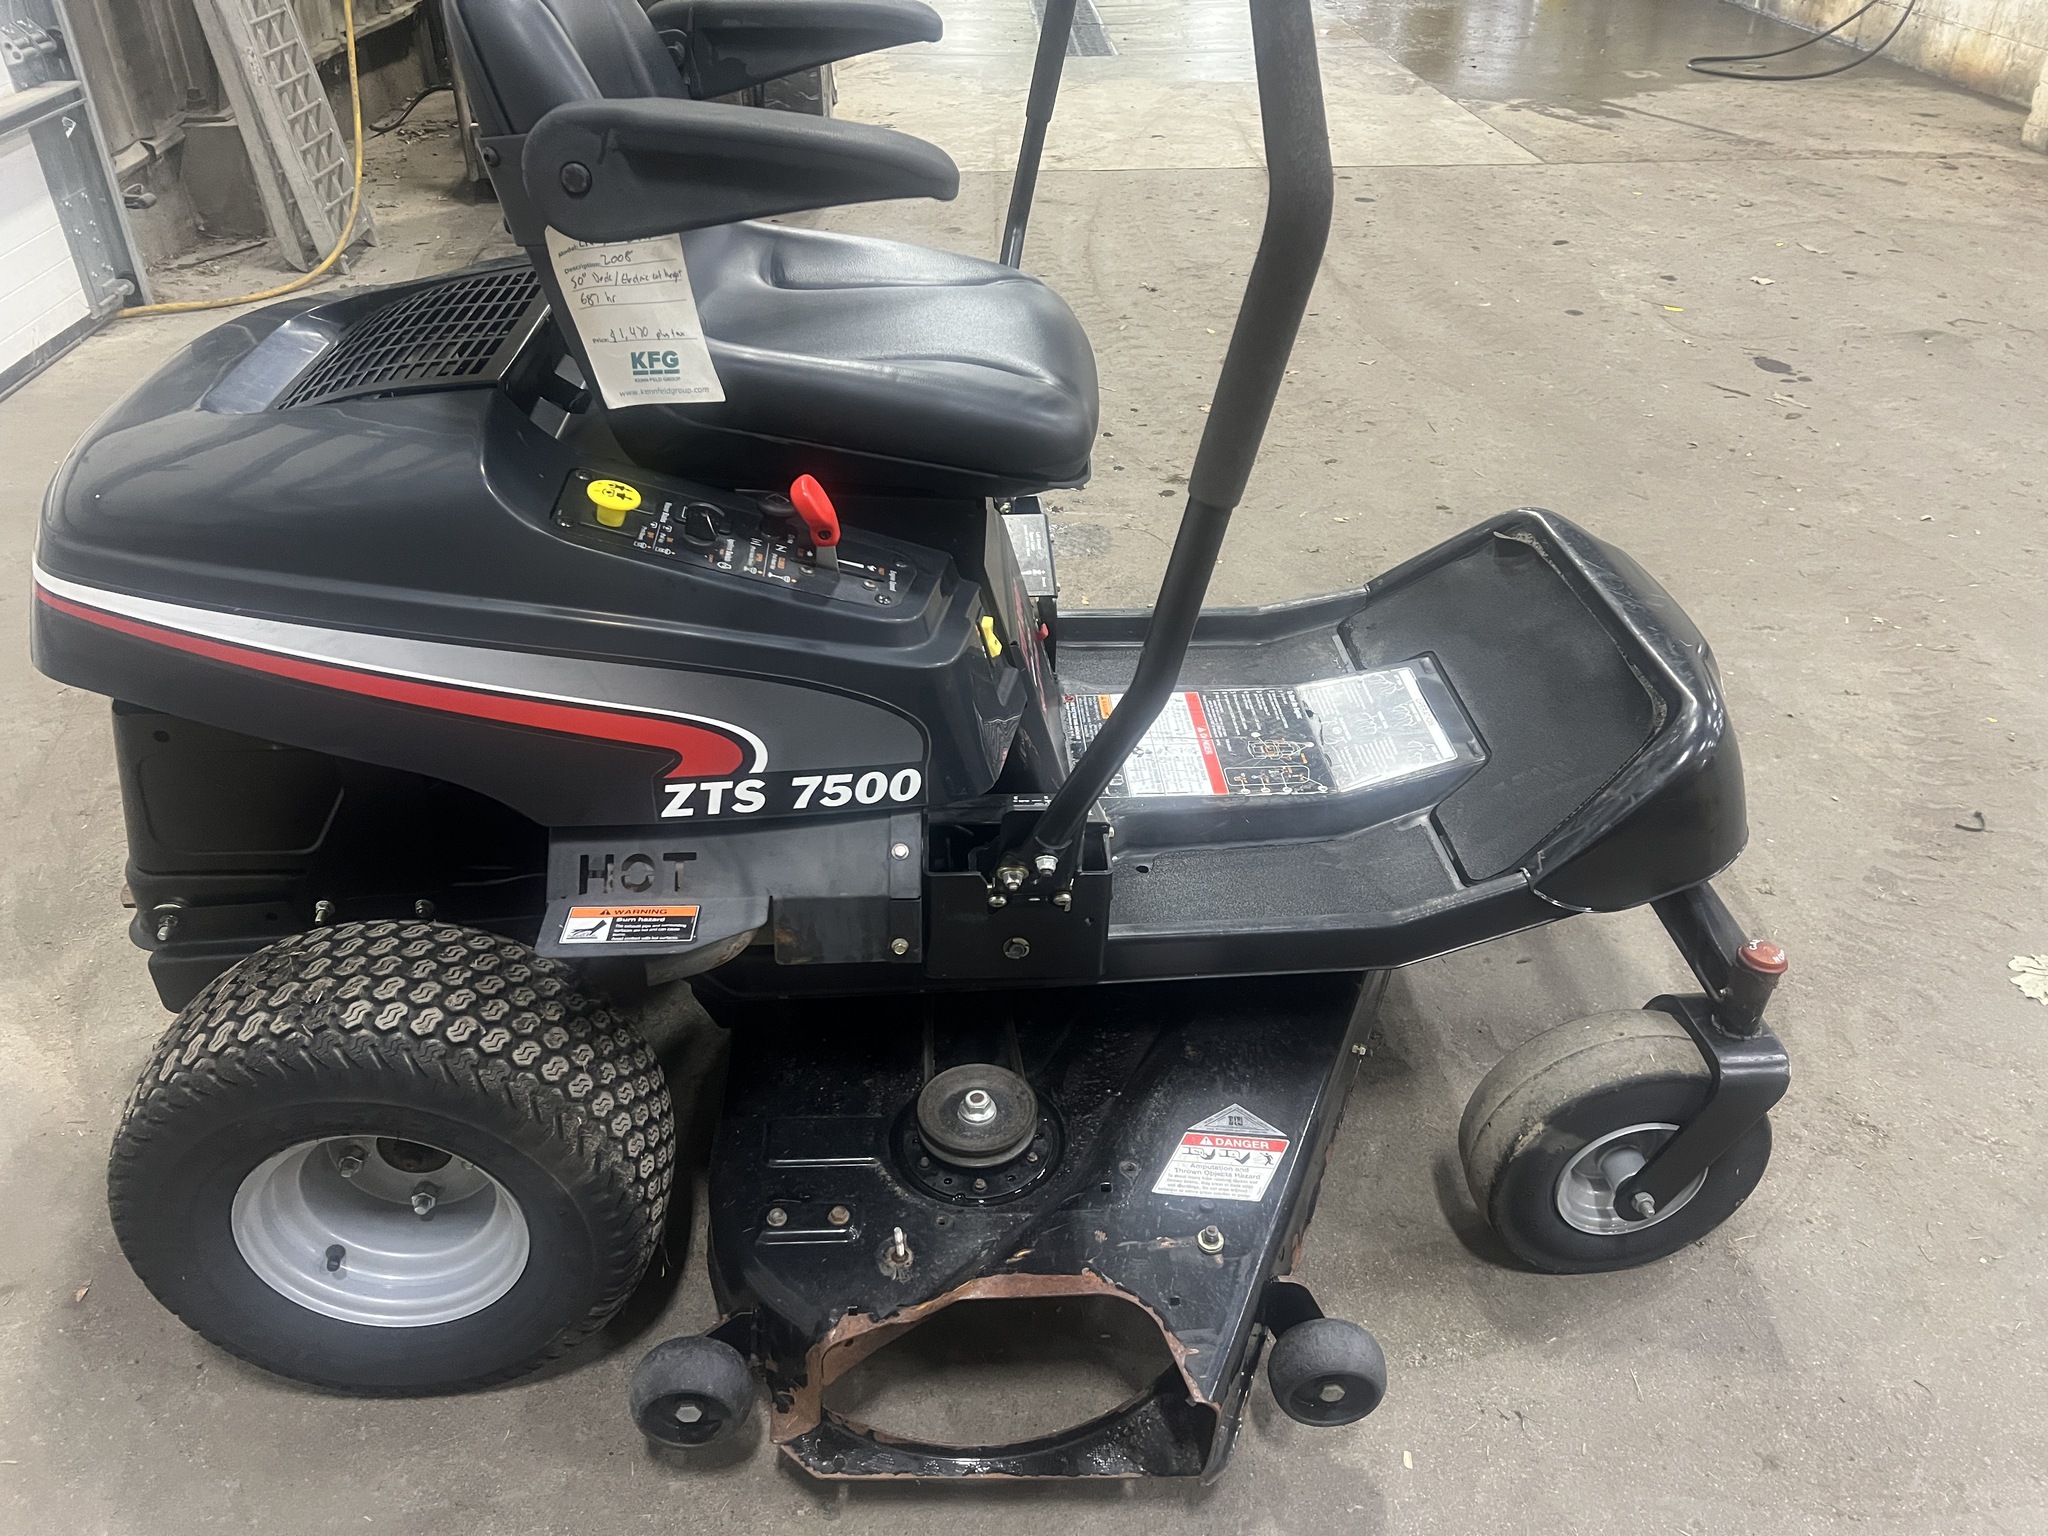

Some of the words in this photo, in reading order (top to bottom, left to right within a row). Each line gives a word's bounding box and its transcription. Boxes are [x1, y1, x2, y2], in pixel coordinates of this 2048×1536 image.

[558, 245, 578, 257] Model:
[564, 263, 600, 274] Description:
[600, 250, 633, 265] 2008
[580, 292, 599, 306] 687
[604, 291, 616, 303] hr
[630, 350, 680, 370] KFG
[619, 386, 710, 397] www.kennfeldgroup.com
[660, 778, 767, 818] ZTS
[791, 768, 922, 810] 7500
[579, 852, 697, 895] HOT
[1215, 1138, 1269, 1149] DANGER
[1174, 1167, 1203, 1176] Thrown
[1203, 1169, 1233, 1178] Objects
[1234, 1172, 1261, 1180] Hazard
[1190, 1163, 1234, 1172] Amputation
